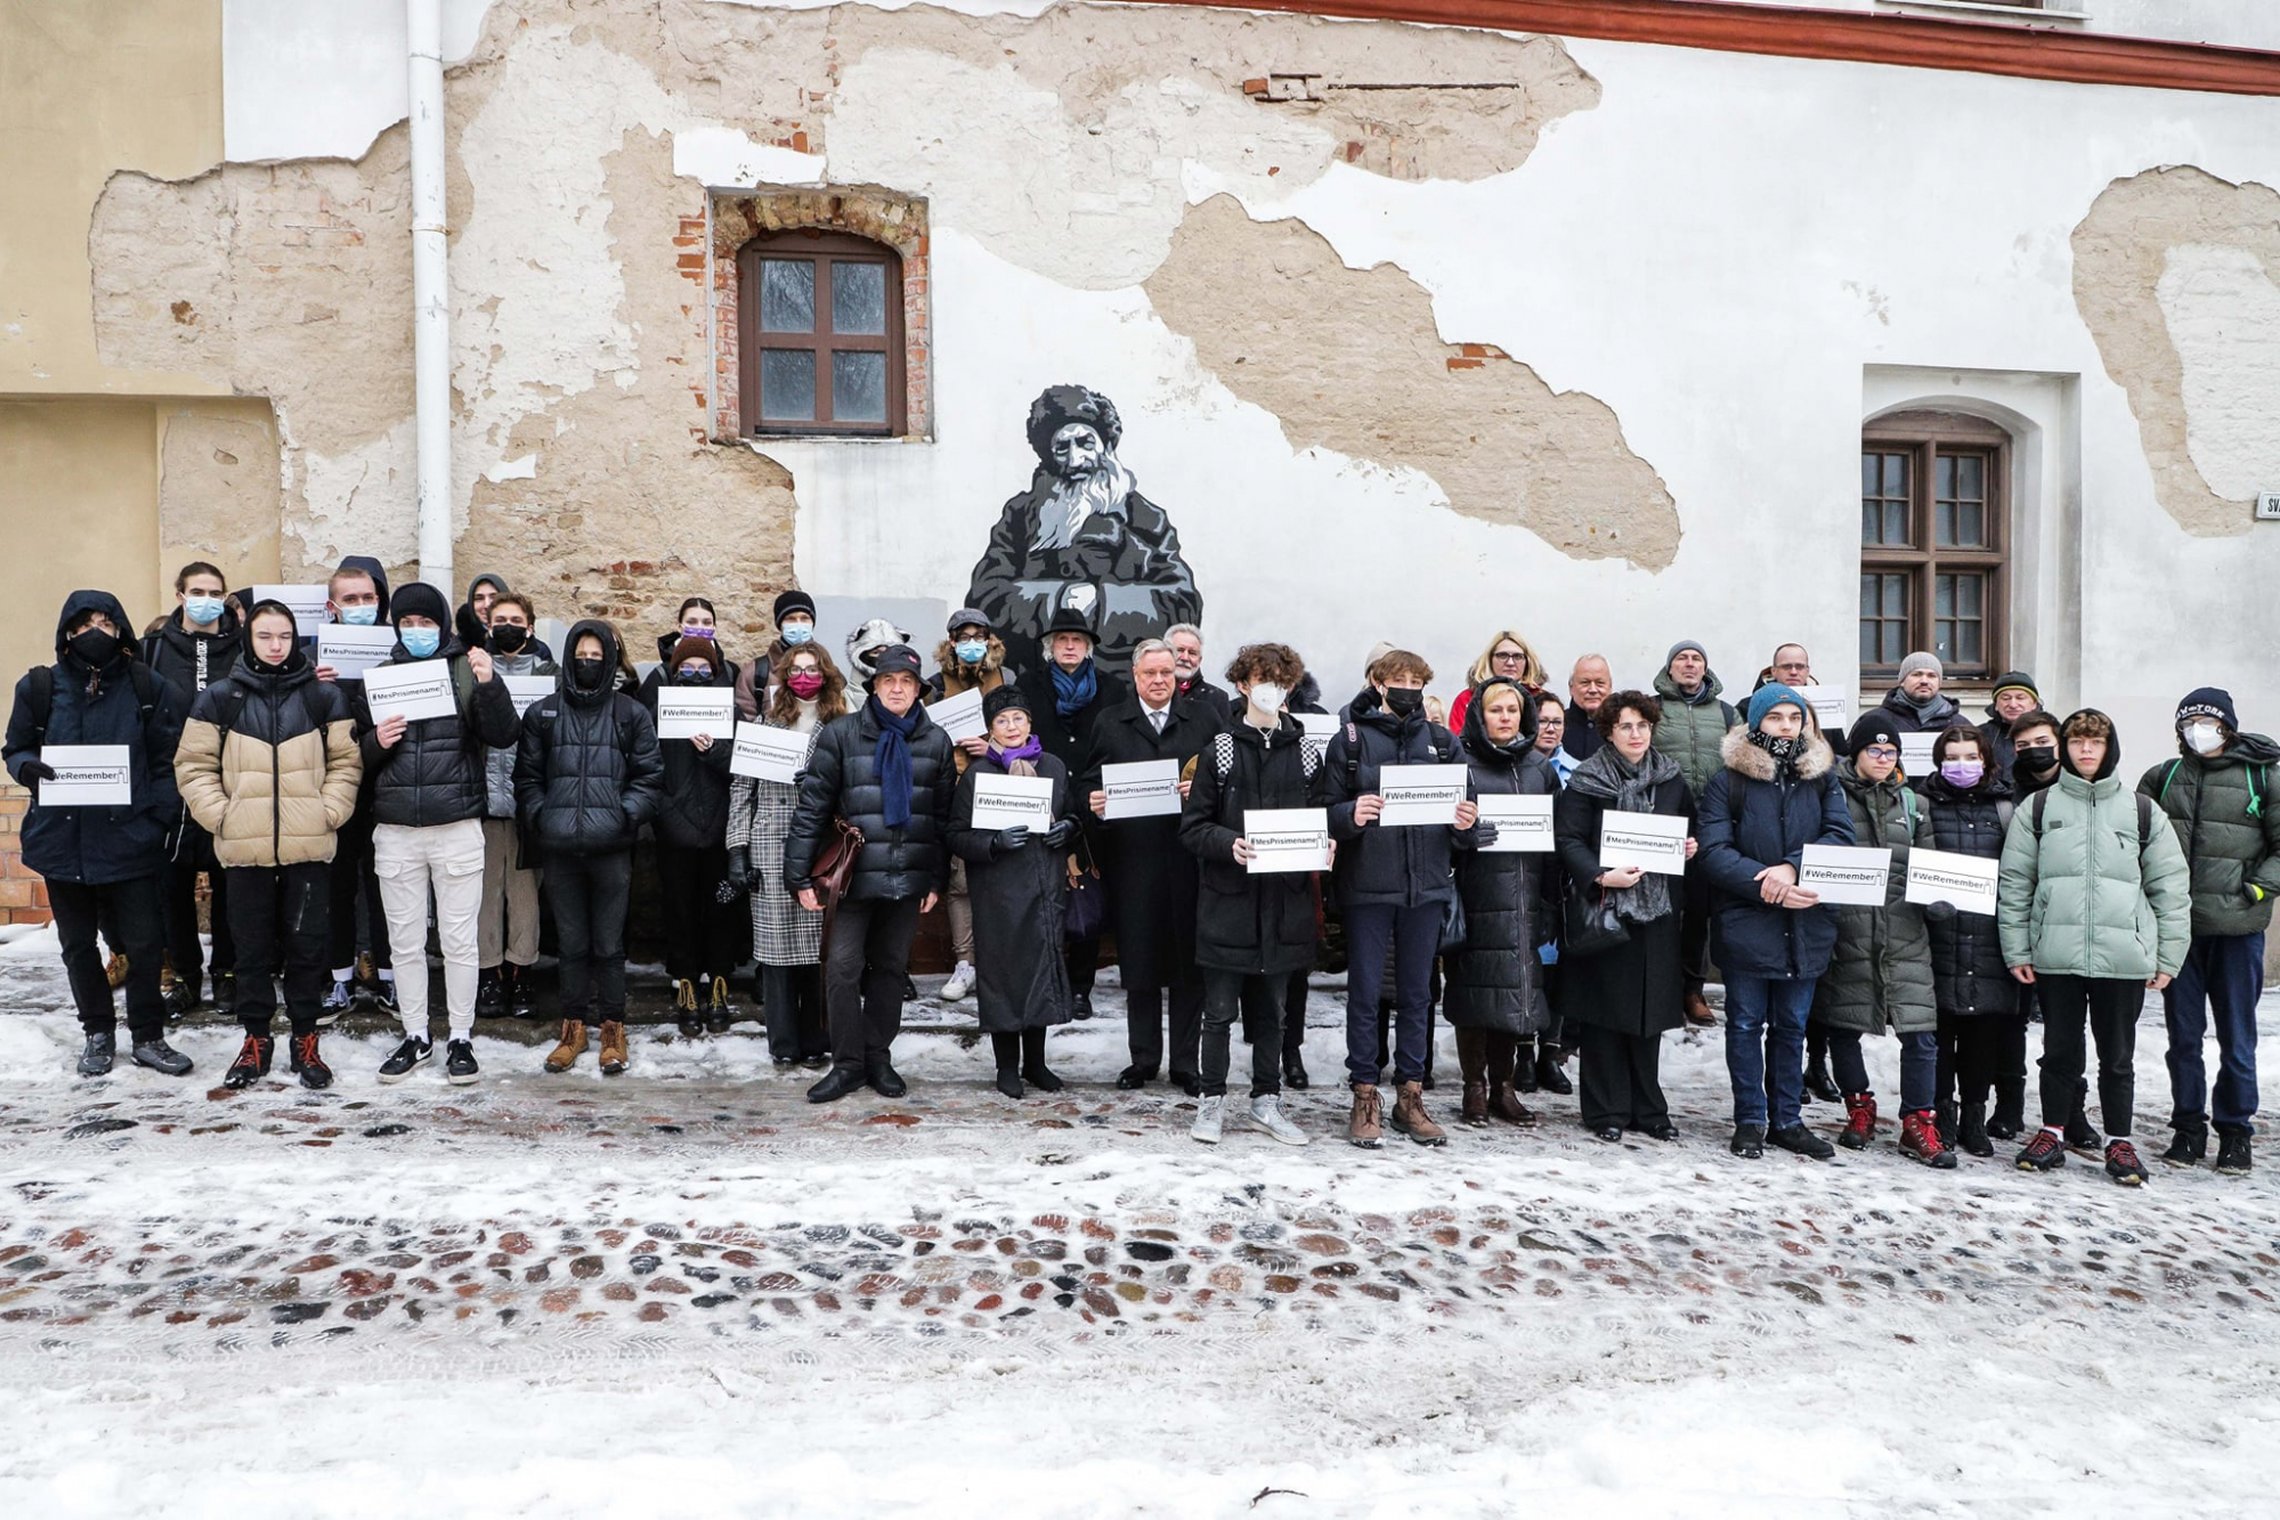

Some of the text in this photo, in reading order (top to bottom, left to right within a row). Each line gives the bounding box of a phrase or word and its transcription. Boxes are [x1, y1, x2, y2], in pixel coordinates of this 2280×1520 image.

[372, 686, 441, 701] #MesPrisimename
[662, 709, 722, 717] #WeRemember
[2196, 704, 2225, 719] YORK
[737, 745, 795, 760] #MesPrisimename
[54, 771, 117, 780] WeRemember
[1108, 785, 1169, 795] #MesPrisimename
[1386, 790, 1454, 800] #WeRemember
[978, 797, 1040, 809] #WeRemember
[1251, 837, 1316, 846] #MesPrisimename
[1606, 835, 1674, 849] #MesPrisimename
[1805, 870, 1875, 880] #WeRemember
[1913, 871, 1984, 888] #WeRemember
